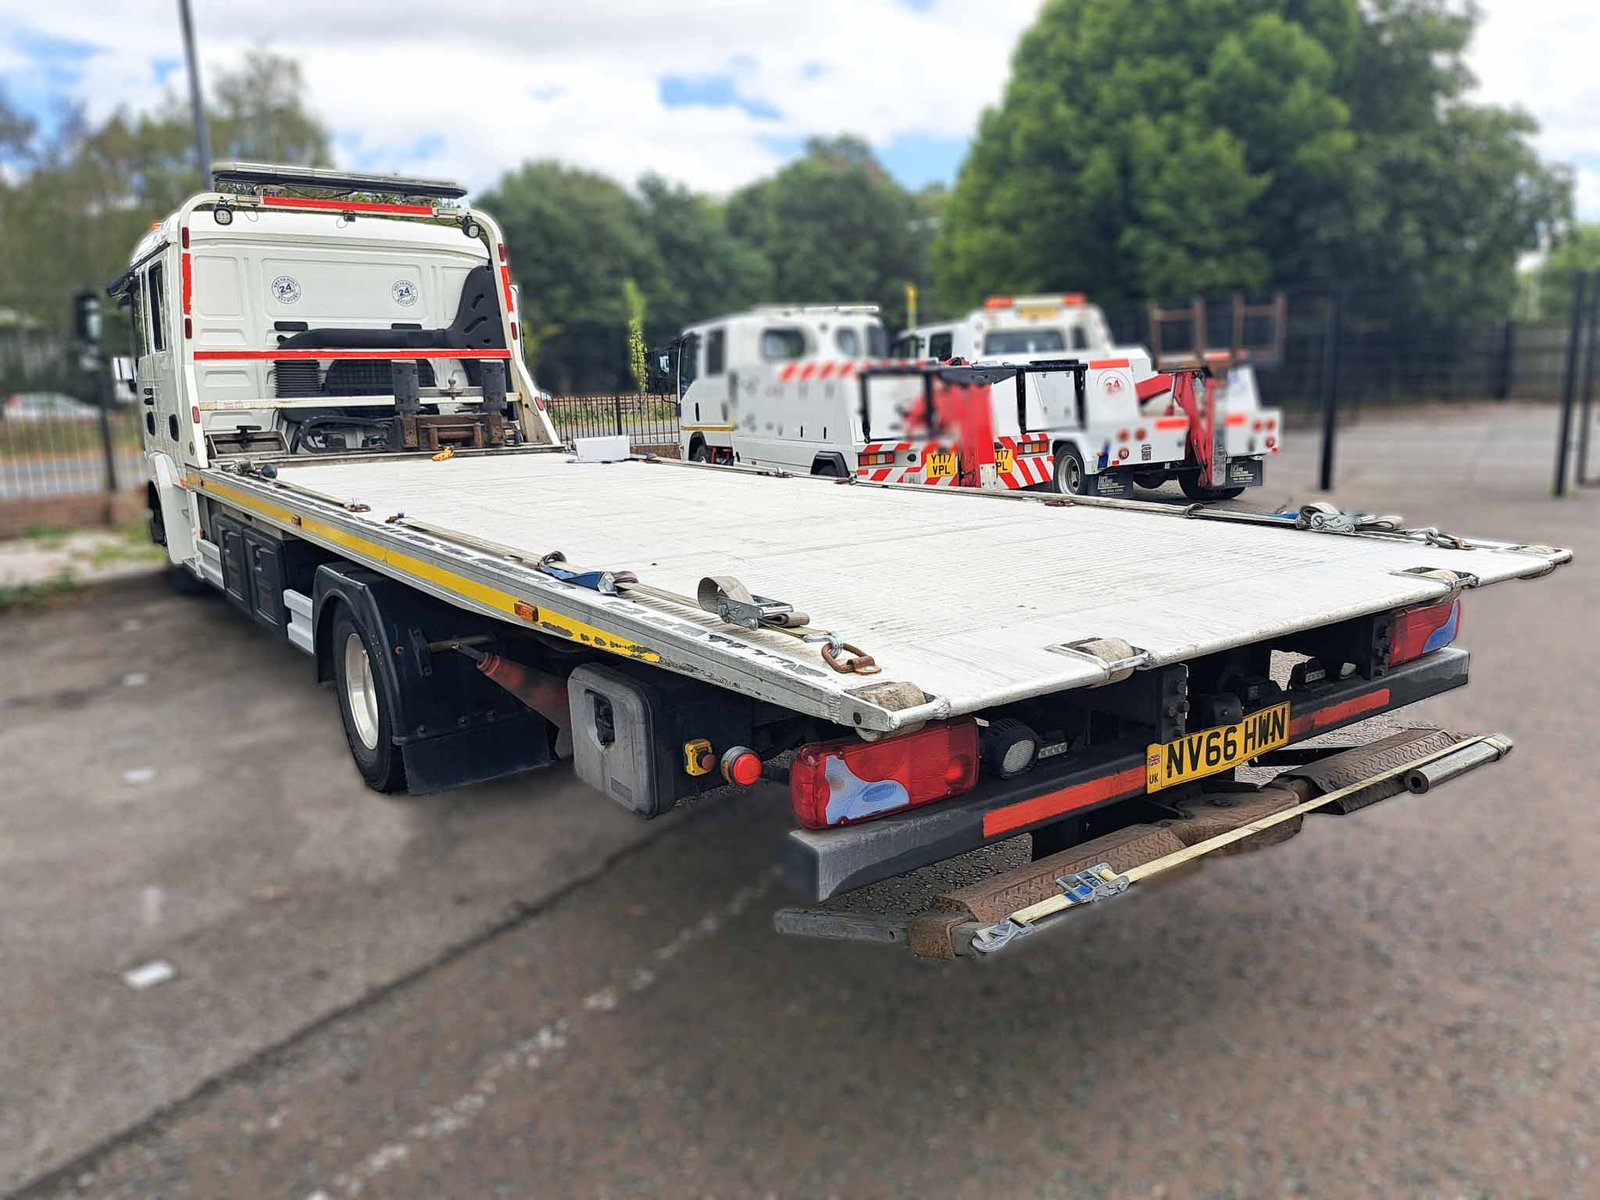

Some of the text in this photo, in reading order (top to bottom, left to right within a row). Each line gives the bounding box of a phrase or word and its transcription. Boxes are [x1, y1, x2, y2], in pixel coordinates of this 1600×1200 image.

[279, 283, 292, 293] 24
[398, 287, 410, 296] 24
[931, 453, 952, 464] YT17
[995, 450, 1009, 460] T17
[932, 465, 951, 475] VPL
[996, 460, 1008, 471] PL
[1167, 707, 1286, 778] NV66 HWN
[1149, 773, 1159, 784] UK
